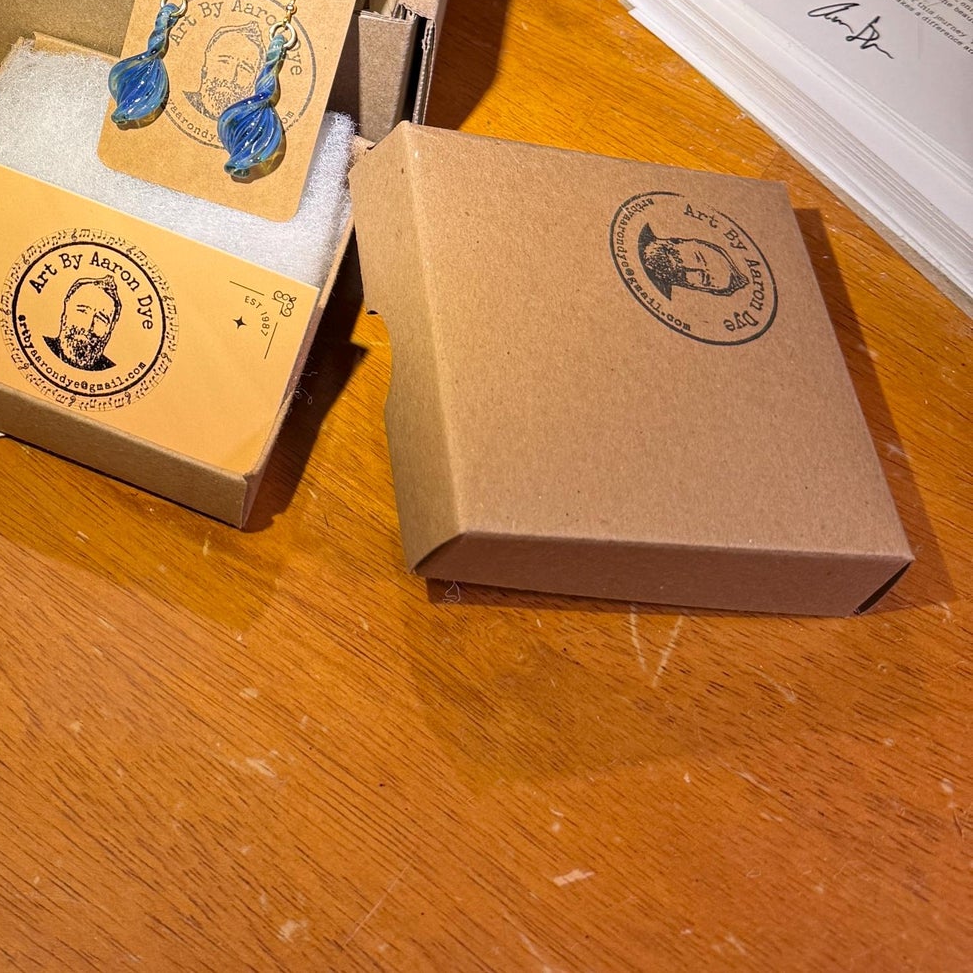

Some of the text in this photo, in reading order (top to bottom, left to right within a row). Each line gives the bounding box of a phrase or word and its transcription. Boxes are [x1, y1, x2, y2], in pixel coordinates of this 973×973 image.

[169, 15, 197, 46] Art
[198, 1, 224, 18] By
[286, 40, 304, 76] ye
[29, 251, 154, 330] Art By Aaron Dye
[683, 203, 765, 332] Art By Aaron Dye
[18, 314, 147, 393] artbyaarondye@gmail.com
[244, 295, 270, 337] EST 1987
